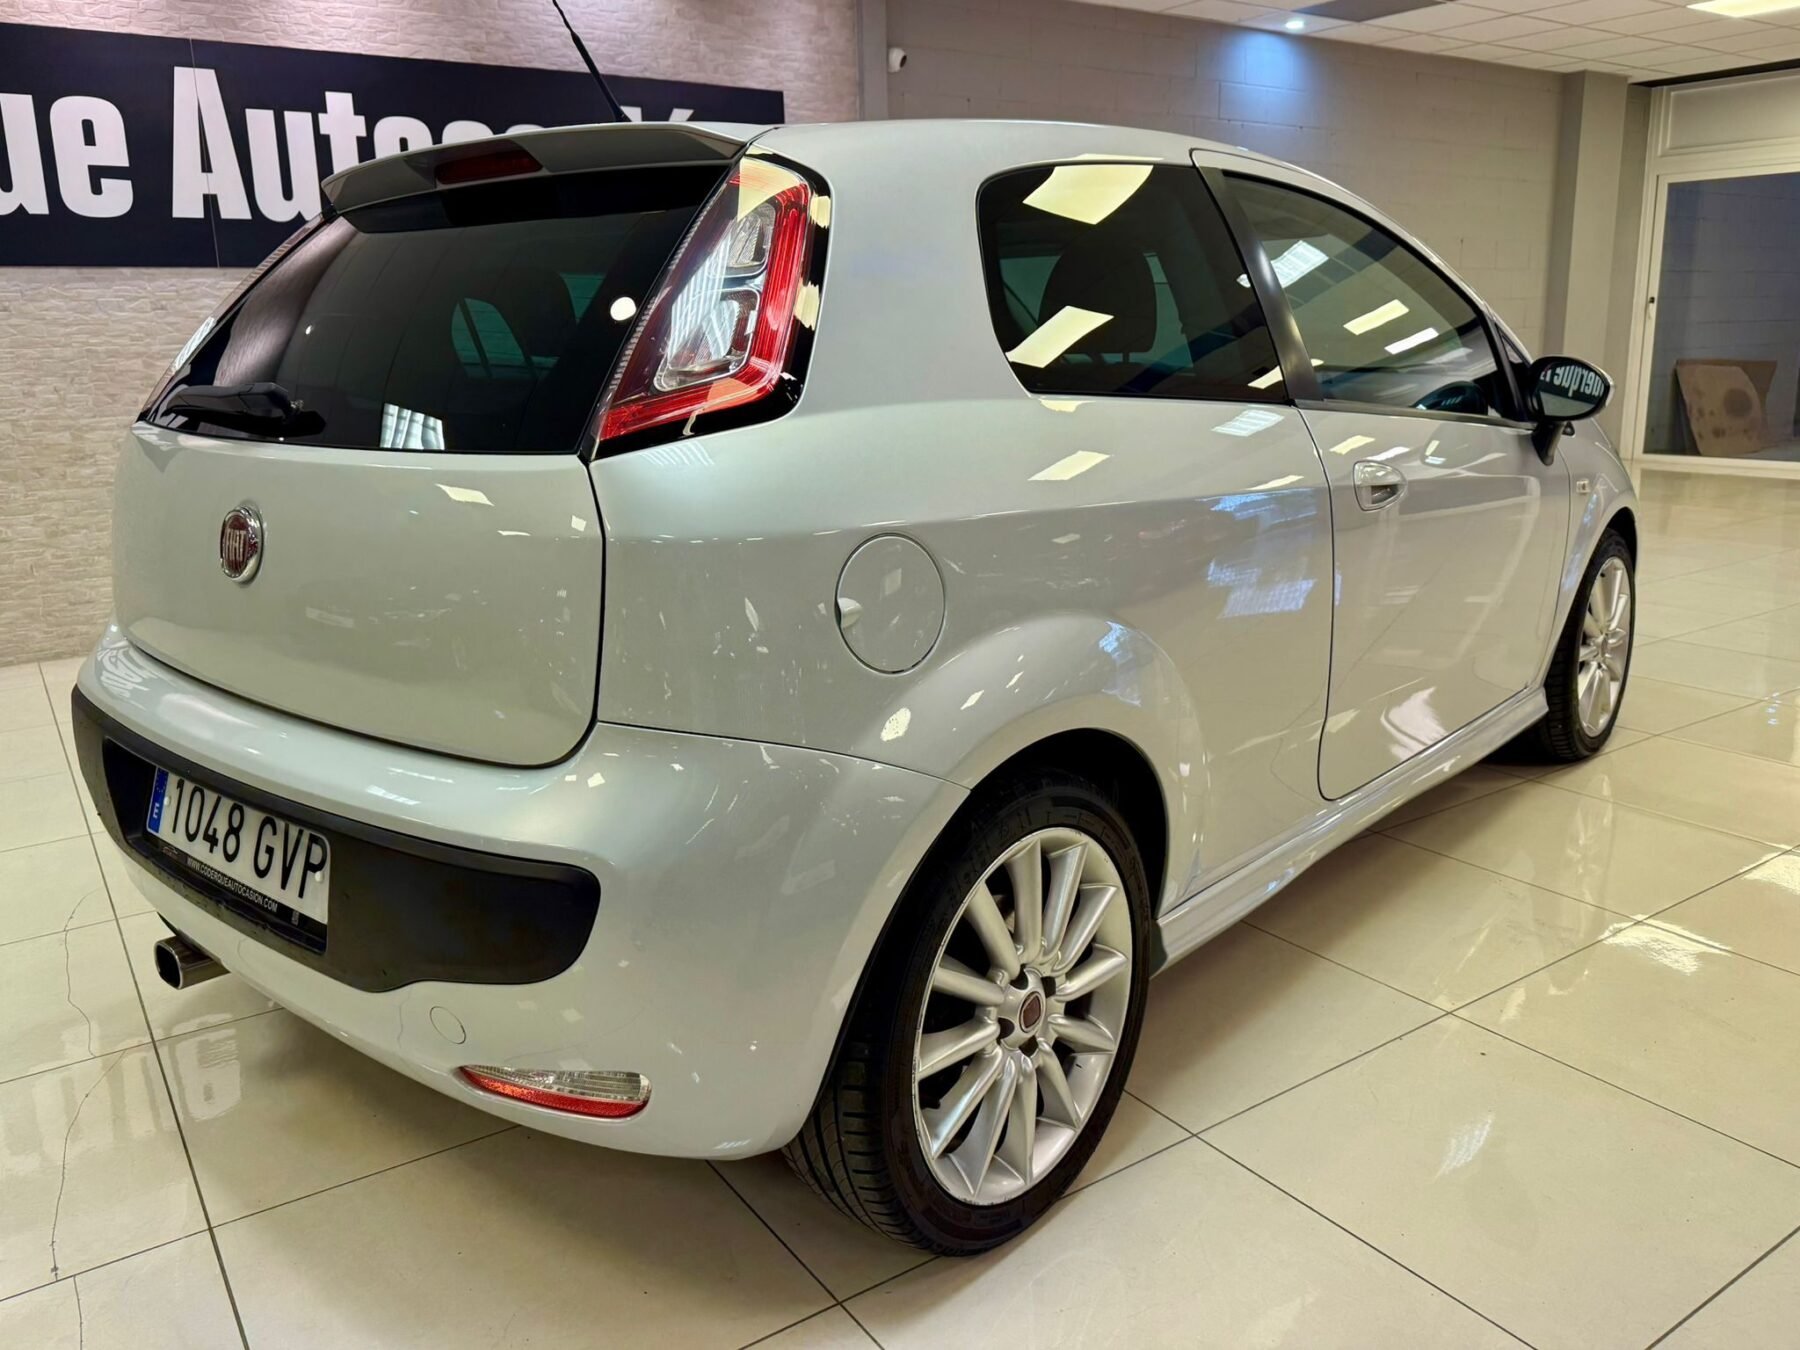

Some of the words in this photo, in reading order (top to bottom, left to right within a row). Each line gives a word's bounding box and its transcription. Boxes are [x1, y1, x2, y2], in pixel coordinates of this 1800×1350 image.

[153, 802, 160, 819] E
[172, 777, 245, 863] 1048
[253, 815, 328, 899] GVP
